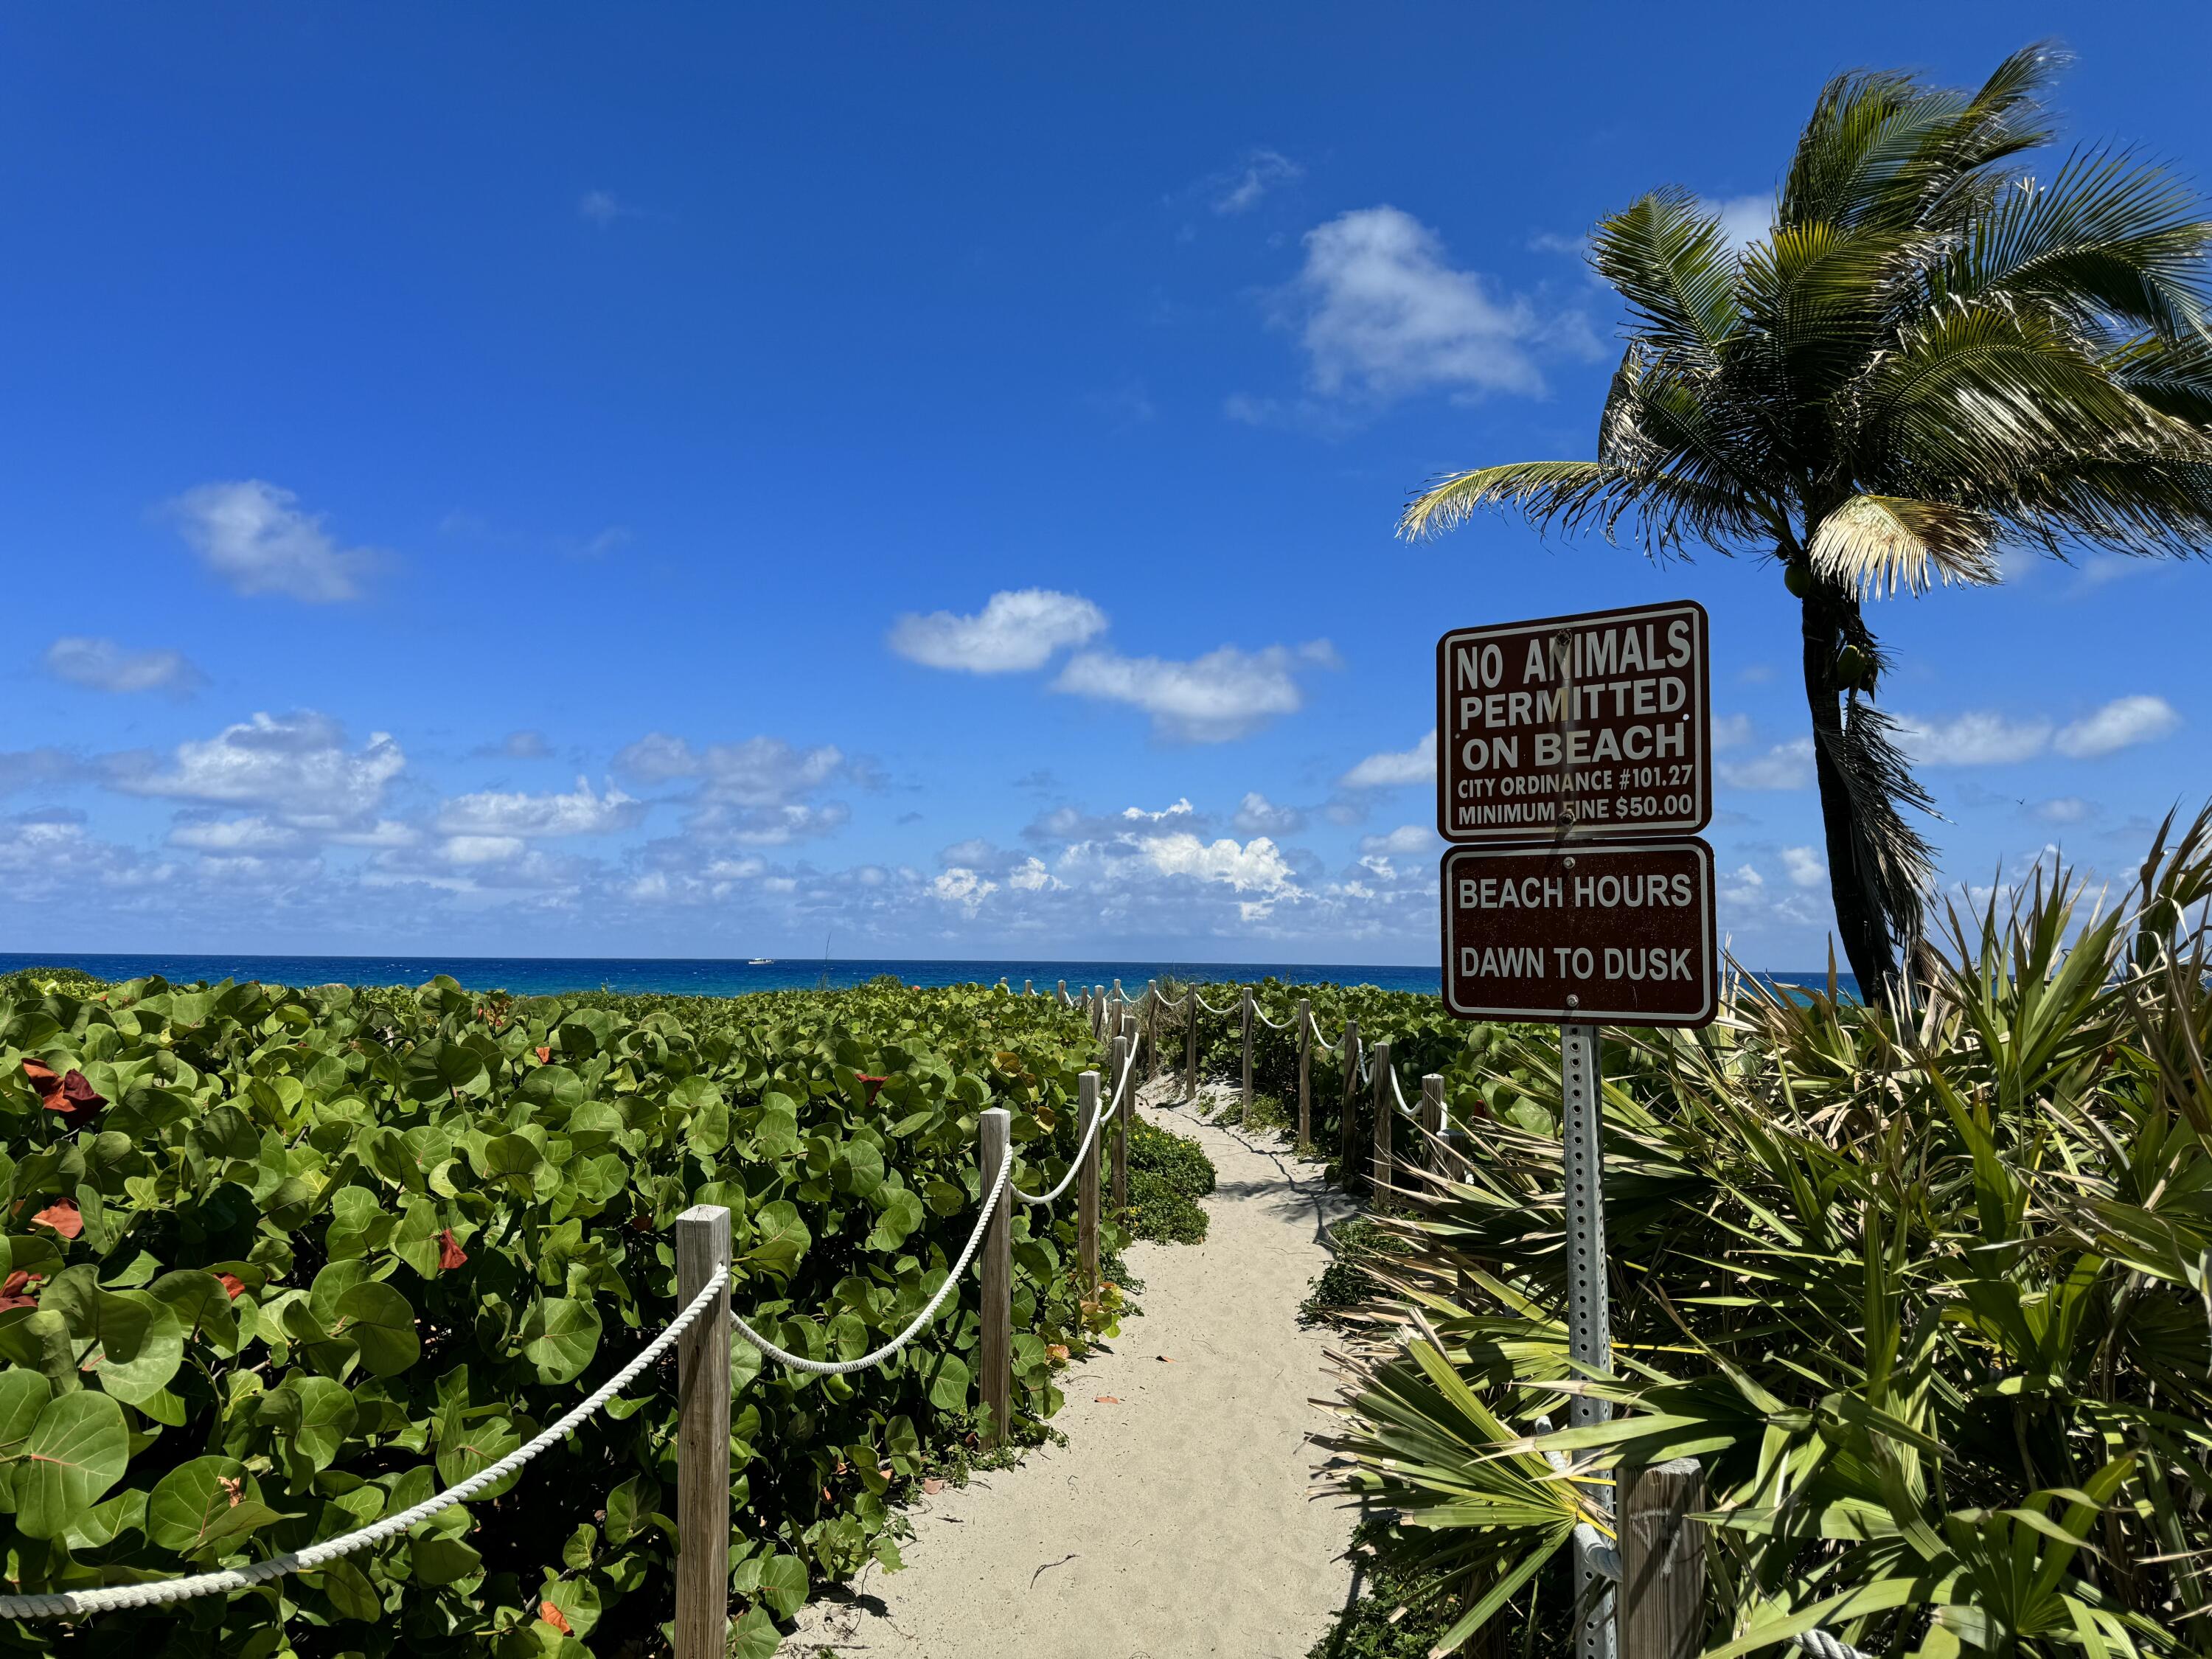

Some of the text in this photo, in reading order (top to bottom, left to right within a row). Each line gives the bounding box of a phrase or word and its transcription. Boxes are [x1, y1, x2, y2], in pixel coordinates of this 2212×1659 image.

[1457, 620, 1691, 691] NO ANIMALS
[1461, 676, 1686, 730] PERMITTED
[1462, 722, 1685, 771] ON BEACH
[1458, 765, 1694, 799] CITY ORDINANCE #101.27
[1458, 802, 1555, 825] MINIMUM
[1615, 794, 1693, 818] $50.00
[1459, 874, 1692, 908] BEACH HOURS
[1461, 947, 1694, 981] DAWN TO DUSK
